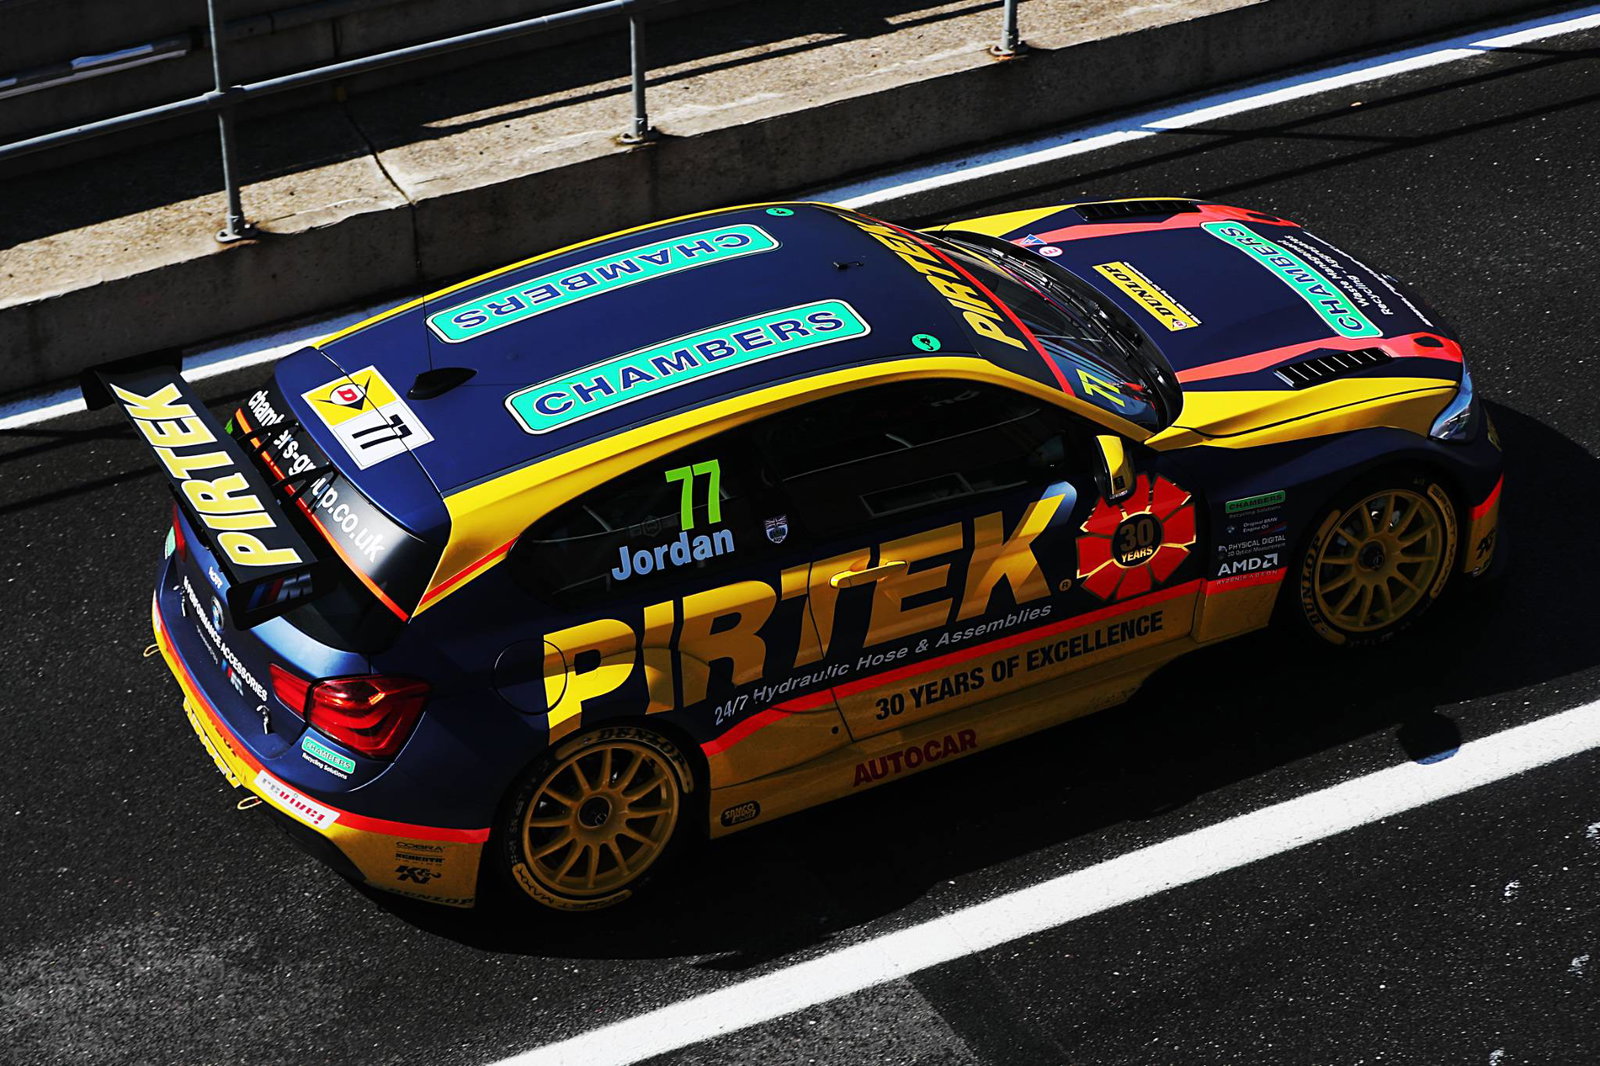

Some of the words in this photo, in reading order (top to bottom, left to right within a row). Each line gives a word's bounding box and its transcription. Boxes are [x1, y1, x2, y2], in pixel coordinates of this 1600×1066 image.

[1276, 239, 1343, 280] Management
[1284, 235, 1343, 270] Aggregates
[452, 233, 753, 329] CHAMBERS
[838, 214, 1028, 351] PIRTEK
[1101, 265, 1176, 316] DUNLOP
[1218, 226, 1363, 332] CHAMBERS
[1340, 280, 1370, 307] Waste
[1347, 274, 1394, 315] Recycling
[534, 311, 845, 417] CHAMBERS
[1075, 368, 1125, 407] 77
[351, 413, 413, 450] 77
[110, 383, 303, 566] PIRTEK
[664, 459, 722, 531] 77
[611, 528, 736, 581] Jordan
[1119, 519, 1154, 551] 30
[1121, 545, 1154, 564] YEARS
[1228, 539, 1260, 550] PHYSICAL
[1262, 534, 1286, 545] DIGITAL
[1217, 556, 1262, 577] AMD
[543, 493, 1067, 746] PIRTEK
[221, 642, 268, 701] ACCESSORIES
[715, 695, 750, 726] 24/7
[753, 662, 849, 705] Hydraulic
[857, 647, 907, 671] Hose
[915, 638, 930, 654] &
[936, 604, 1052, 648] Assemblies
[875, 692, 905, 721] 30
[910, 667, 985, 708] YEARS
[991, 655, 1020, 685] OF
[1026, 610, 1163, 671] EXCELLENCE
[304, 741, 352, 769] CHAMBERS
[853, 729, 978, 787] AUTOCAR
[396, 841, 444, 852] COBRA
